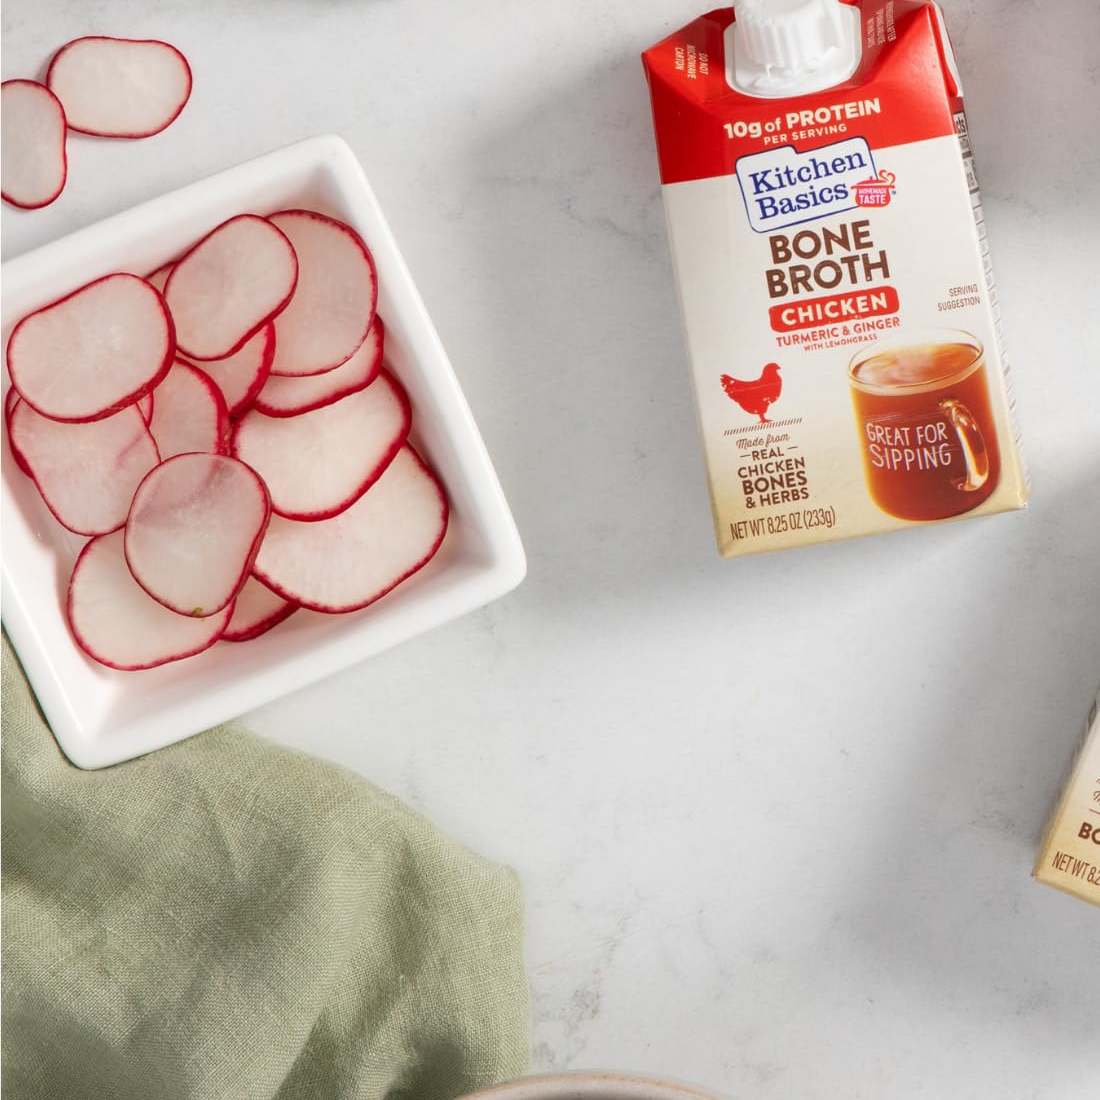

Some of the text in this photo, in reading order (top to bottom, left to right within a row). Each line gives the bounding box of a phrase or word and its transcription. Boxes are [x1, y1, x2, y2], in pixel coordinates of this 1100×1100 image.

[675, 48, 684, 70] CARTON
[699, 63, 708, 75] NOT
[724, 98, 881, 140] 10g of PROTEIN
[764, 124, 847, 145] PER SERVING
[749, 151, 867, 195] Kitchen
[755, 183, 848, 220] Basics
[859, 195, 885, 204] TASTE
[769, 220, 874, 265] BONE
[766, 251, 891, 298] BROTH
[949, 284, 978, 298] SERVING
[781, 295, 888, 326] CHICKEN
[938, 296, 980, 312] SUGGESTION
[776, 318, 900, 348] TURMERIC & GINGER
[804, 334, 878, 352] WITH LEMONGRASS
[736, 432, 790, 450] Made from
[866, 422, 948, 447] GREAT FOR
[752, 449, 784, 461] REAL
[870, 443, 951, 471] SIPPING
[738, 457, 805, 479] CHICKEN
[742, 470, 808, 495] BONES
[746, 488, 809, 509] & HERBS
[730, 507, 836, 541] NET WT 8.25 OZ (233g)
[1050, 851, 1072, 872] NET
[1071, 858, 1091, 879] WT
